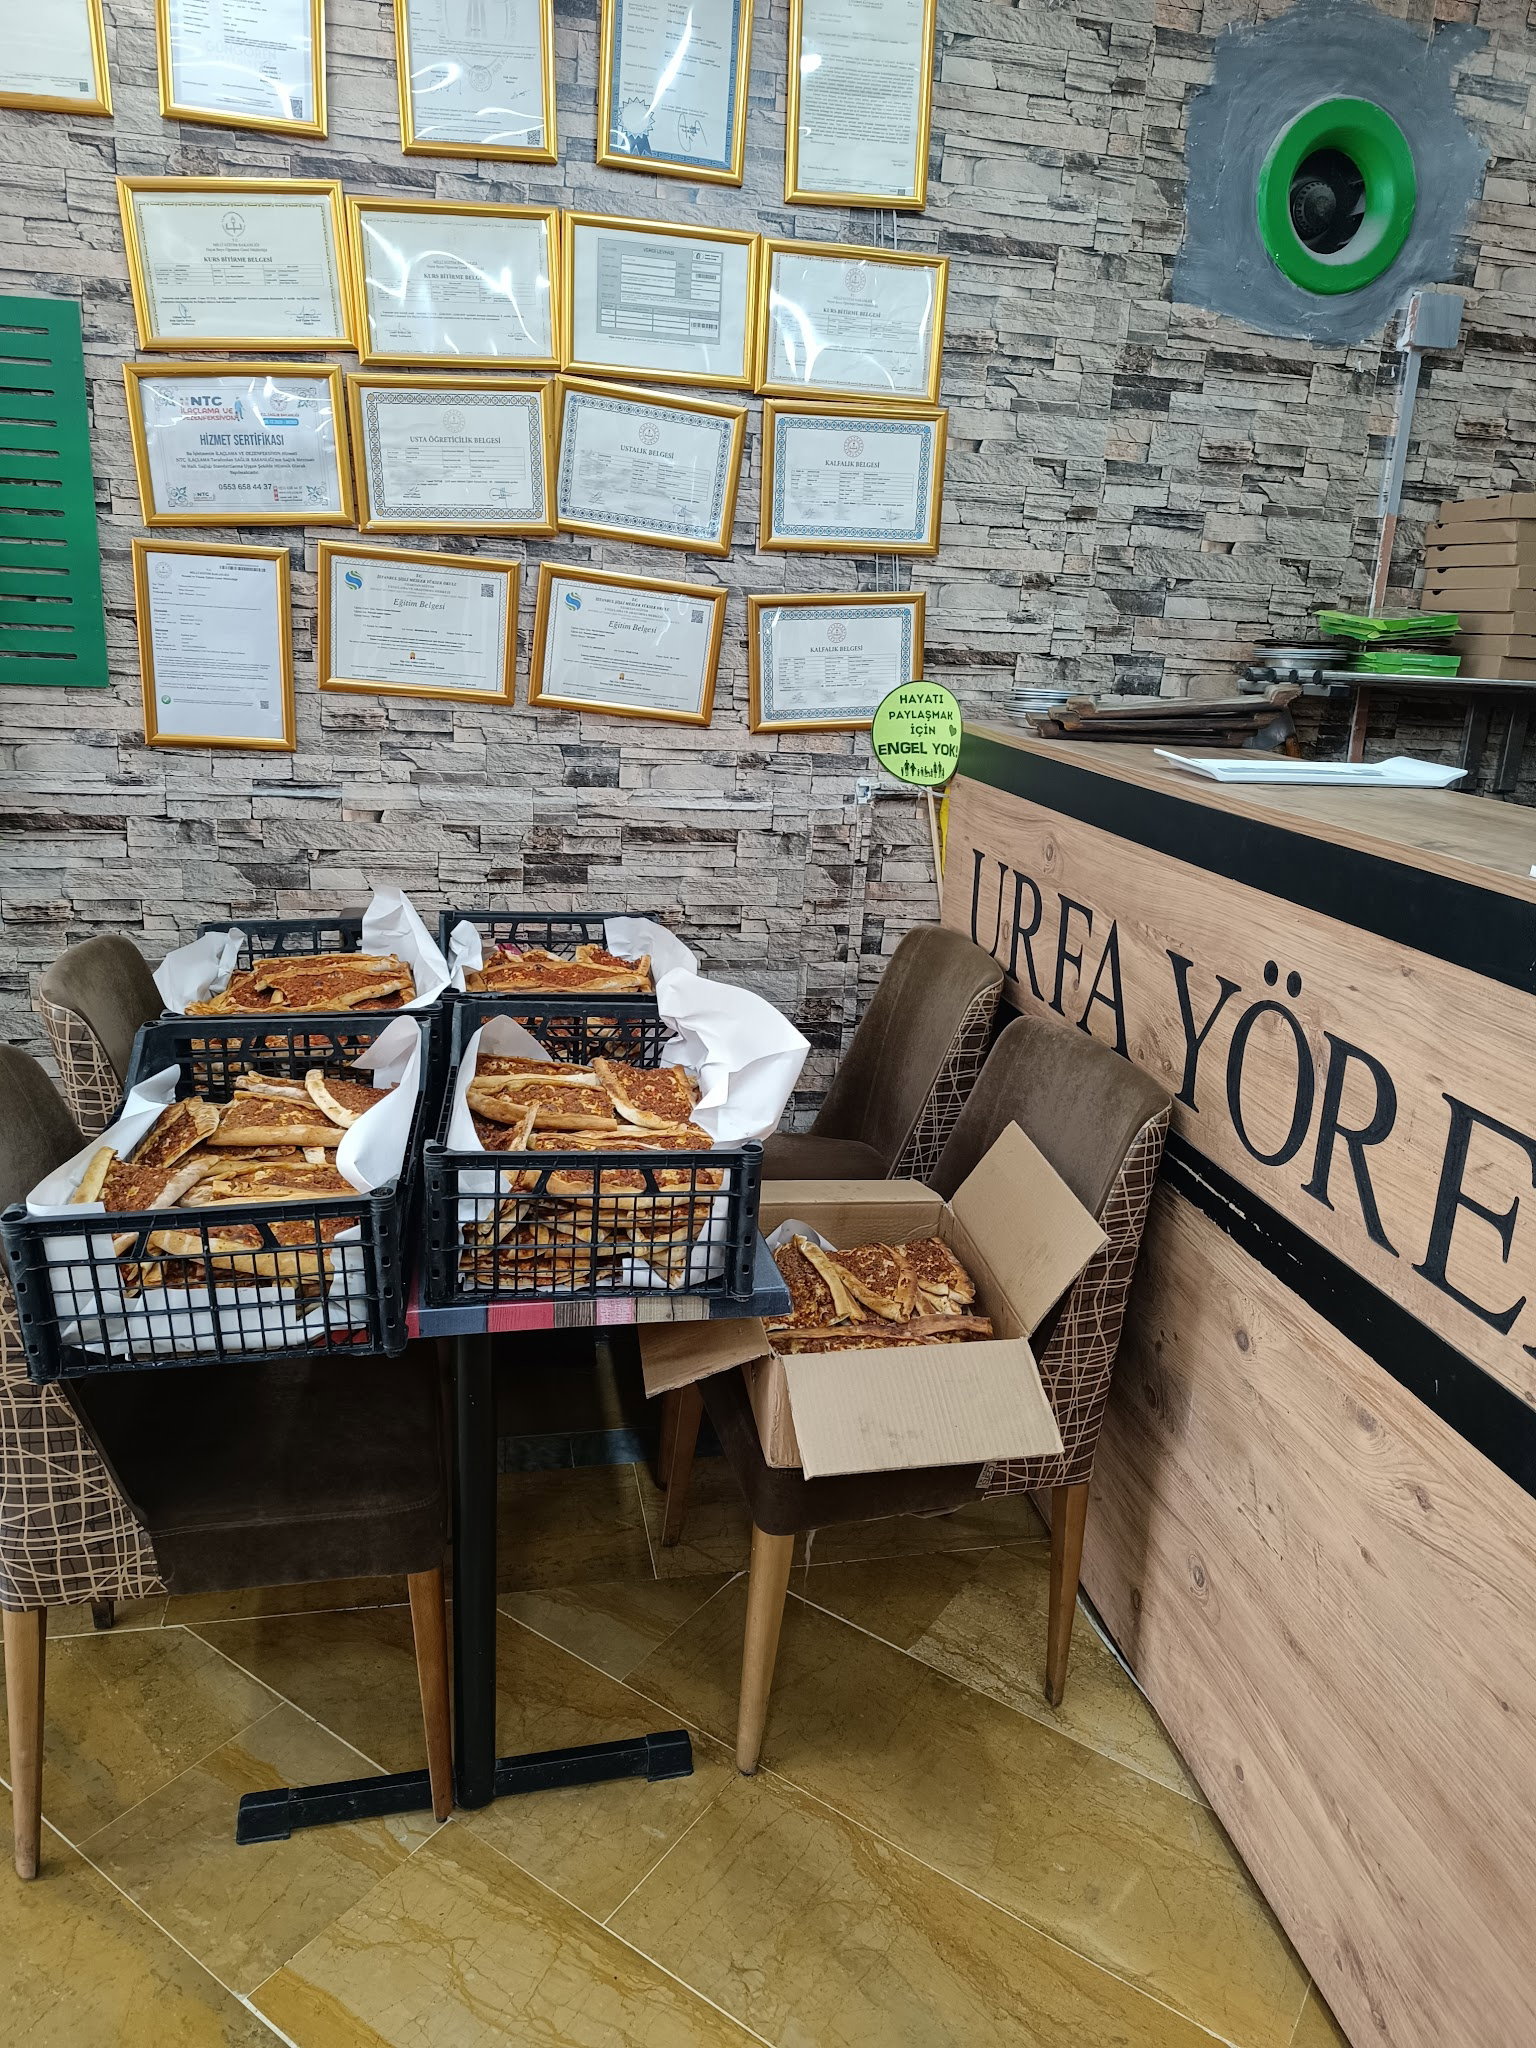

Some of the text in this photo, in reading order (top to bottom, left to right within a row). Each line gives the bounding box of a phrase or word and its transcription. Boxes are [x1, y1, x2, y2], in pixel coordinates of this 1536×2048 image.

[190, 396, 223, 406] NTC
[200, 432, 285, 446] HİZMET SERTİFİKASI
[409, 435, 428, 443] USTA
[474, 436, 501, 444] BELGESİ
[620, 444, 675, 460] USTALIK BELGESİ
[825, 459, 880, 469] KALFALIK BELGESİ
[393, 598, 446, 610] Eğitim Belgesi
[608, 620, 657, 634] Eğitim Belgesi
[839, 644, 863, 652] BELGESİ
[899, 693, 944, 704] HAYATI
[888, 710, 953, 722] PAYLAŞMAK
[910, 723, 936, 737] İÇİN
[877, 741, 959, 758] ENGEL YOK!
[969, 848, 1536, 1361] URFA YÖRE
